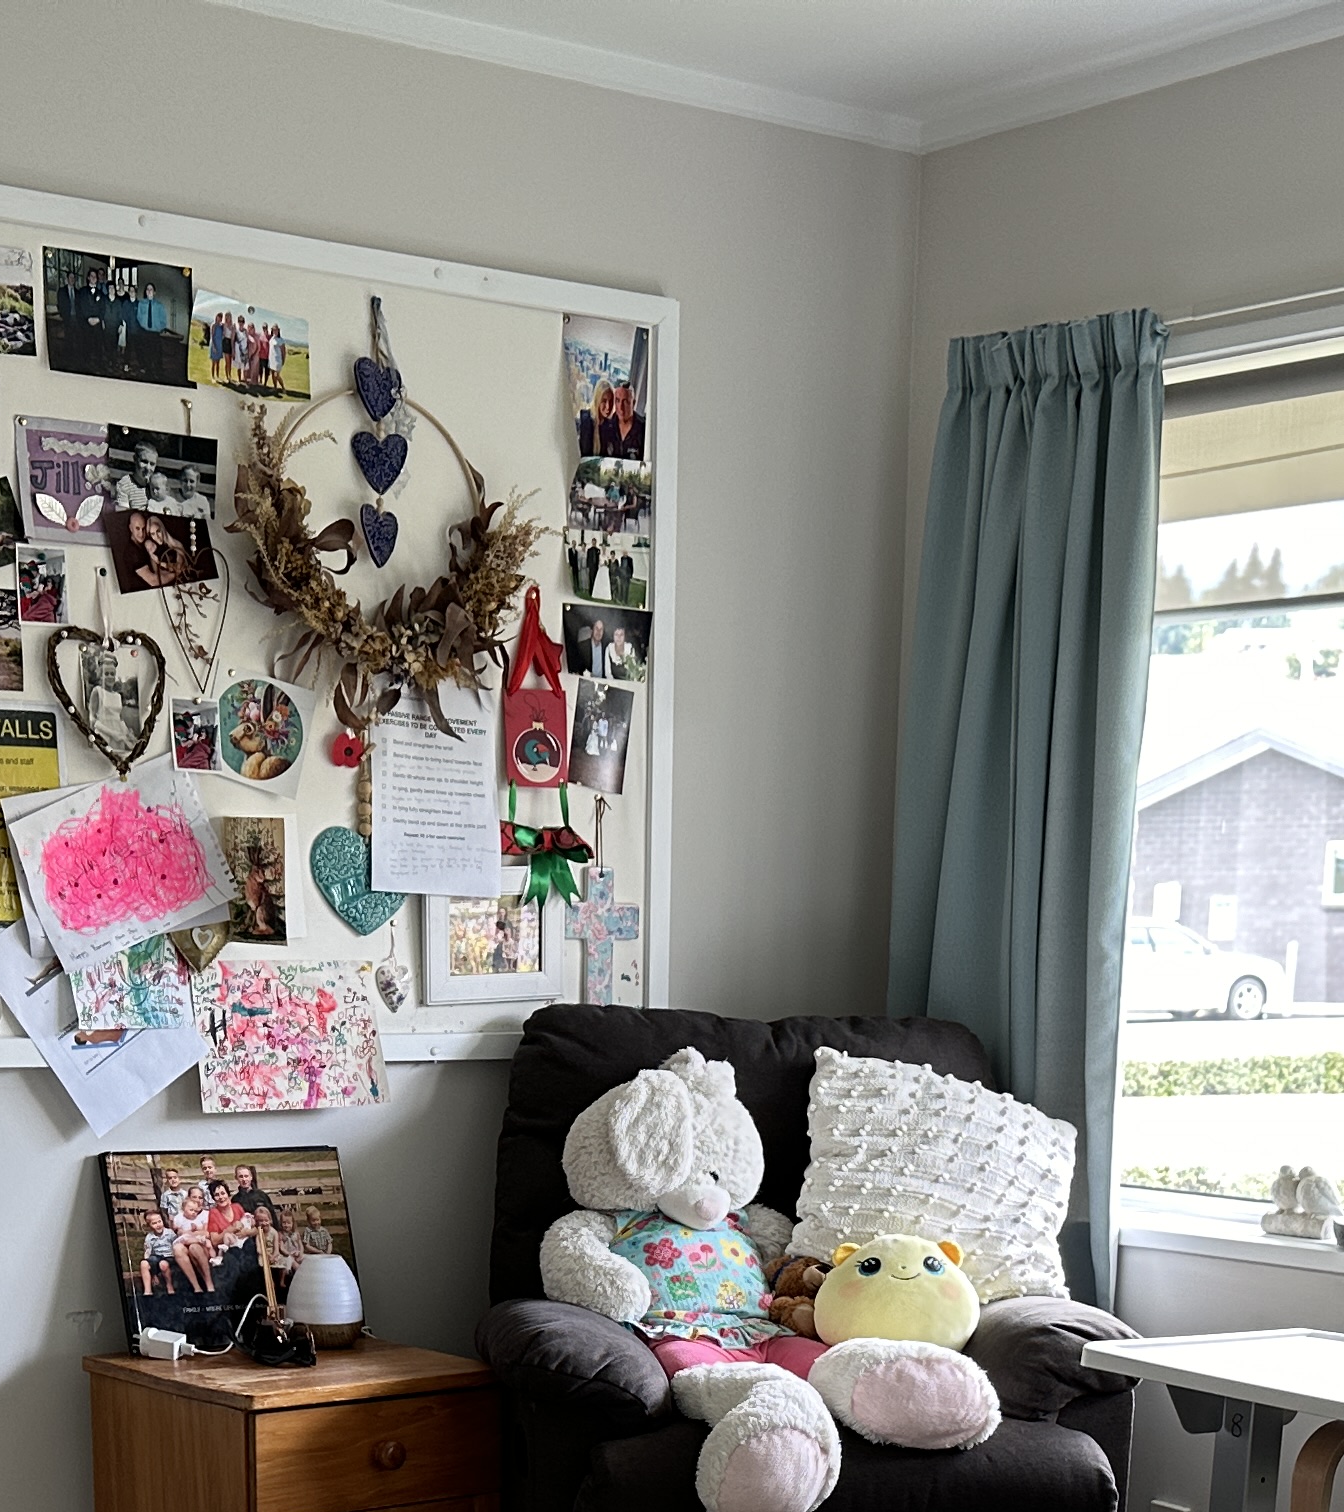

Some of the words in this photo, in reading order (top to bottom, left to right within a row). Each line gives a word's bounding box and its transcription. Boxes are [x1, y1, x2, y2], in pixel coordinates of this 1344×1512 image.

[30, 460, 81, 496] Jill
[5, 757, 19, 765] and
[20, 757, 34, 765] staff
[0, 847, 12, 858] RI
[1231, 1413, 1244, 1438] 8
